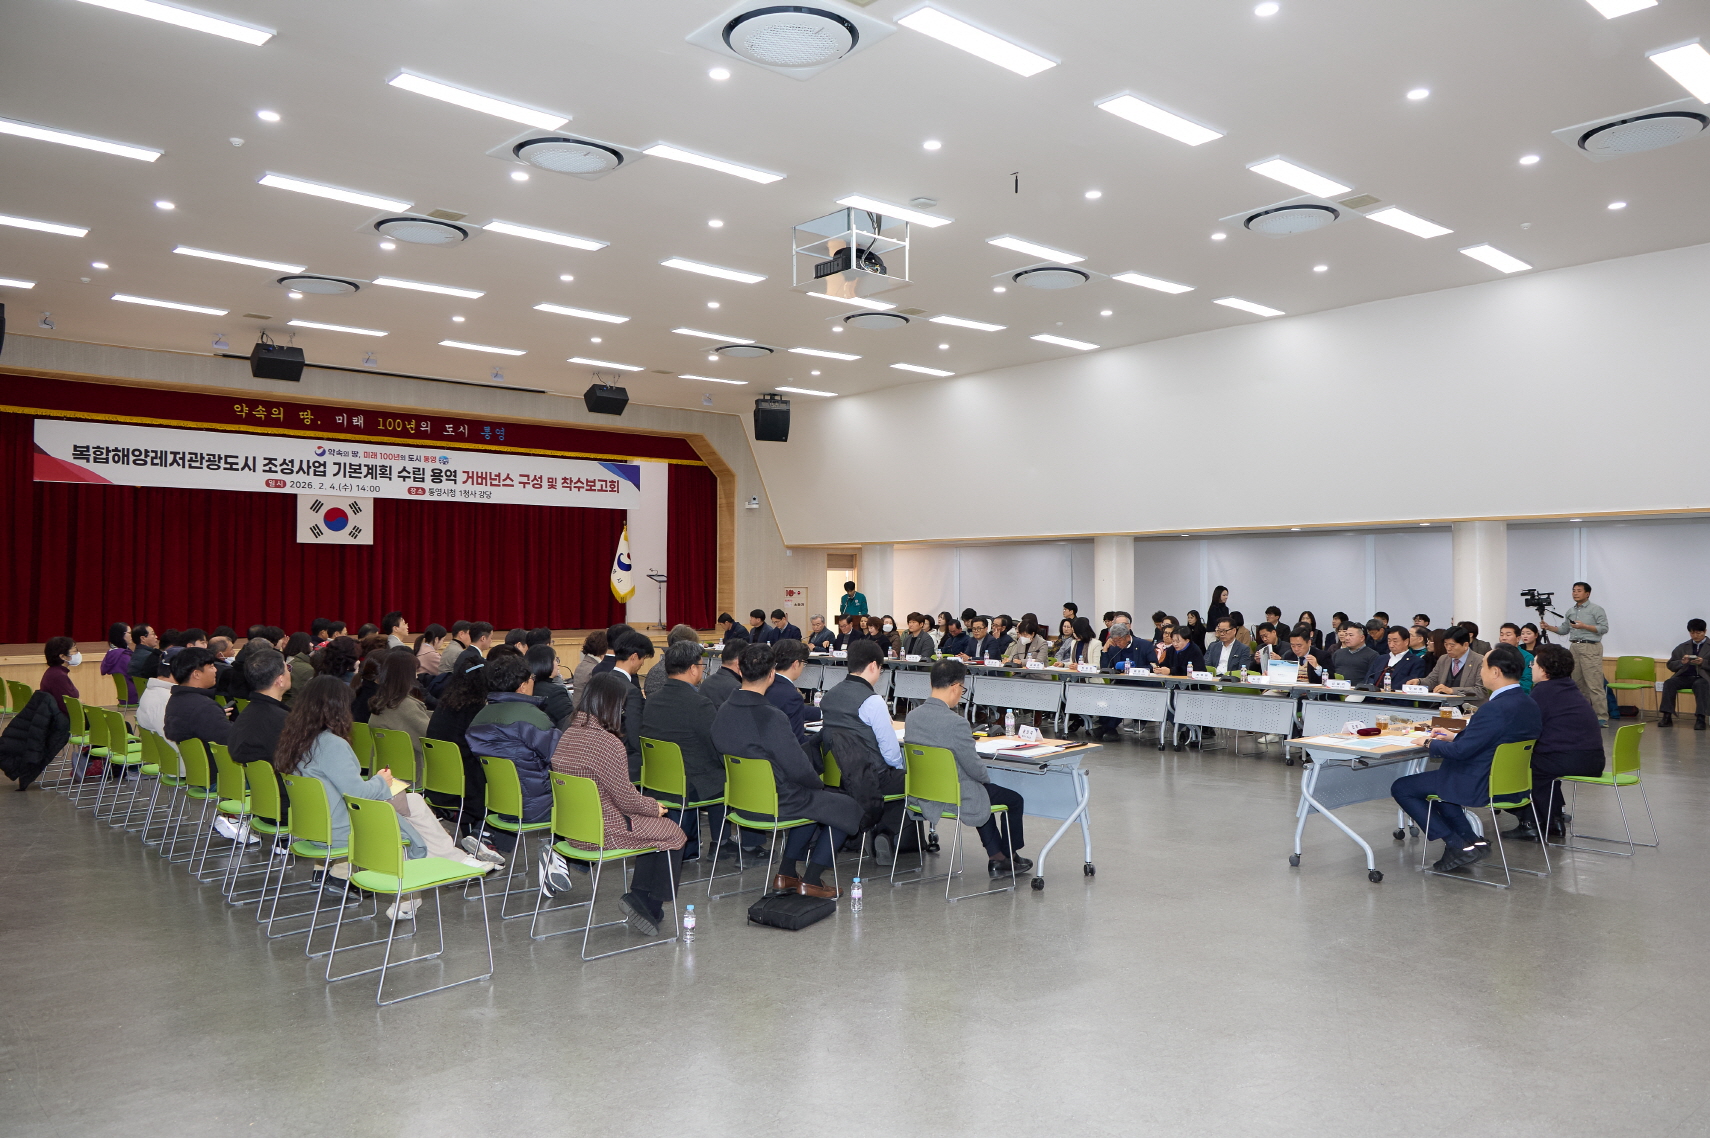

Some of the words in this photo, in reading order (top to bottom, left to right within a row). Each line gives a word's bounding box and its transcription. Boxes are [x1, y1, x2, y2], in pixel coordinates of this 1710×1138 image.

[234, 403, 284, 422] 약속의
[335, 413, 364, 429] 미래
[377, 418, 431, 434] 100년의
[443, 424, 468, 438] 도시
[480, 426, 505, 441] 통영
[328, 448, 350, 457] 약속의
[363, 451, 377, 459] 미래
[379, 452, 406, 461] 100년의
[407, 454, 422, 463] 도시
[423, 455, 437, 463] 통영
[72, 444, 257, 473] 복합해양레저관광도시
[262, 456, 327, 477] 조성사업
[332, 461, 393, 481] 기본계획
[397, 466, 426, 483] 수립
[430, 467, 458, 485] 용역
[461, 470, 515, 488] 거버넌스
[518, 473, 543, 490] 구성
[547, 477, 557, 490] 및
[561, 476, 621, 494] 착수보고회
[289, 480, 316, 490] 2026.
[318, 482, 327, 491] 2.
[329, 482, 353, 492] 4.(수)
[355, 484, 381, 493] 14:00
[427, 488, 456, 498] 통영시청
[458, 490, 477, 499] 1청사
[478, 490, 493, 499] 강당
